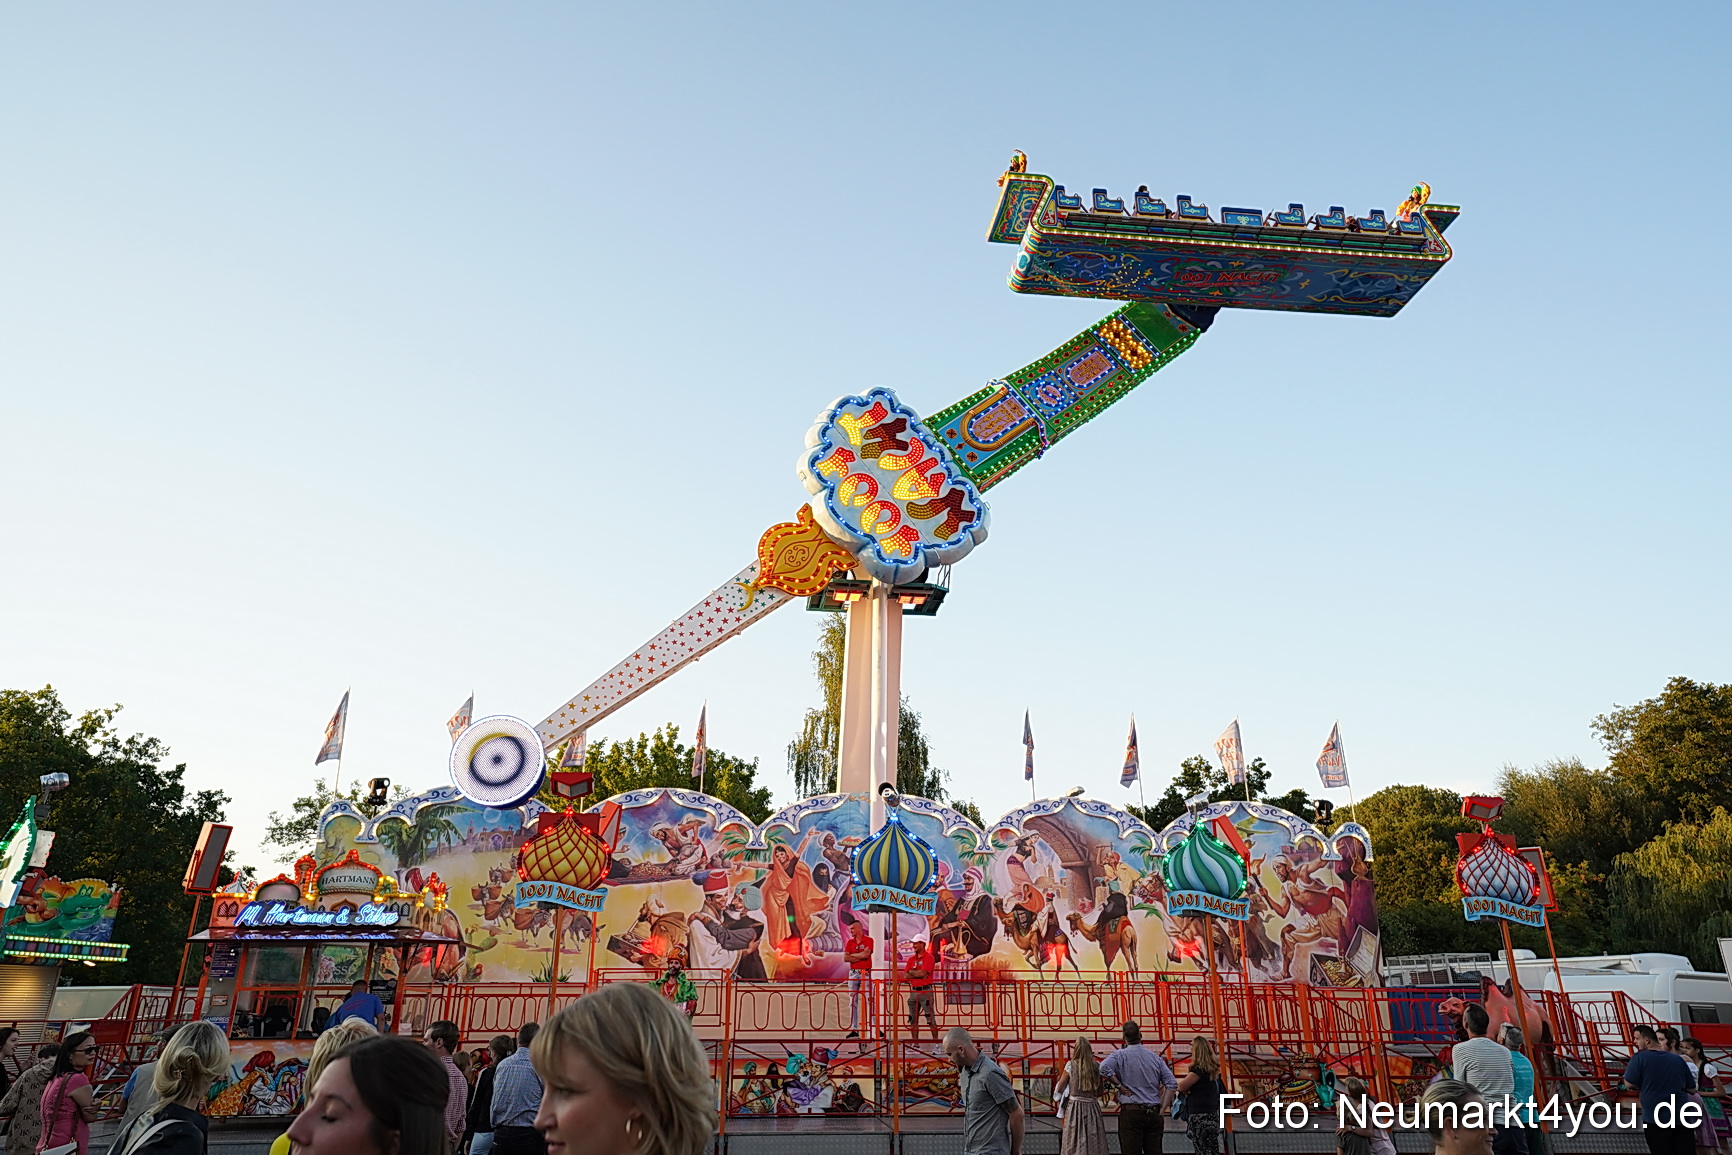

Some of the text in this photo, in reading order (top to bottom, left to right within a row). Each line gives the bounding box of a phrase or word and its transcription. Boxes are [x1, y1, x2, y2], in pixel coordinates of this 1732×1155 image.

[1217, 271, 1283, 283] NACHT
[816, 446, 919, 557] 1001
[321, 875, 376, 885] HARTMANN
[519, 883, 604, 908] 1001 NACHT
[855, 887, 934, 911] 1001 NACHT
[1169, 893, 1247, 916] 1001 NACHT
[262, 903, 333, 925] Hartmann
[336, 908, 350, 924] &
[354, 902, 399, 924] Söhne
[1466, 899, 1541, 923] 1001 NACHT
